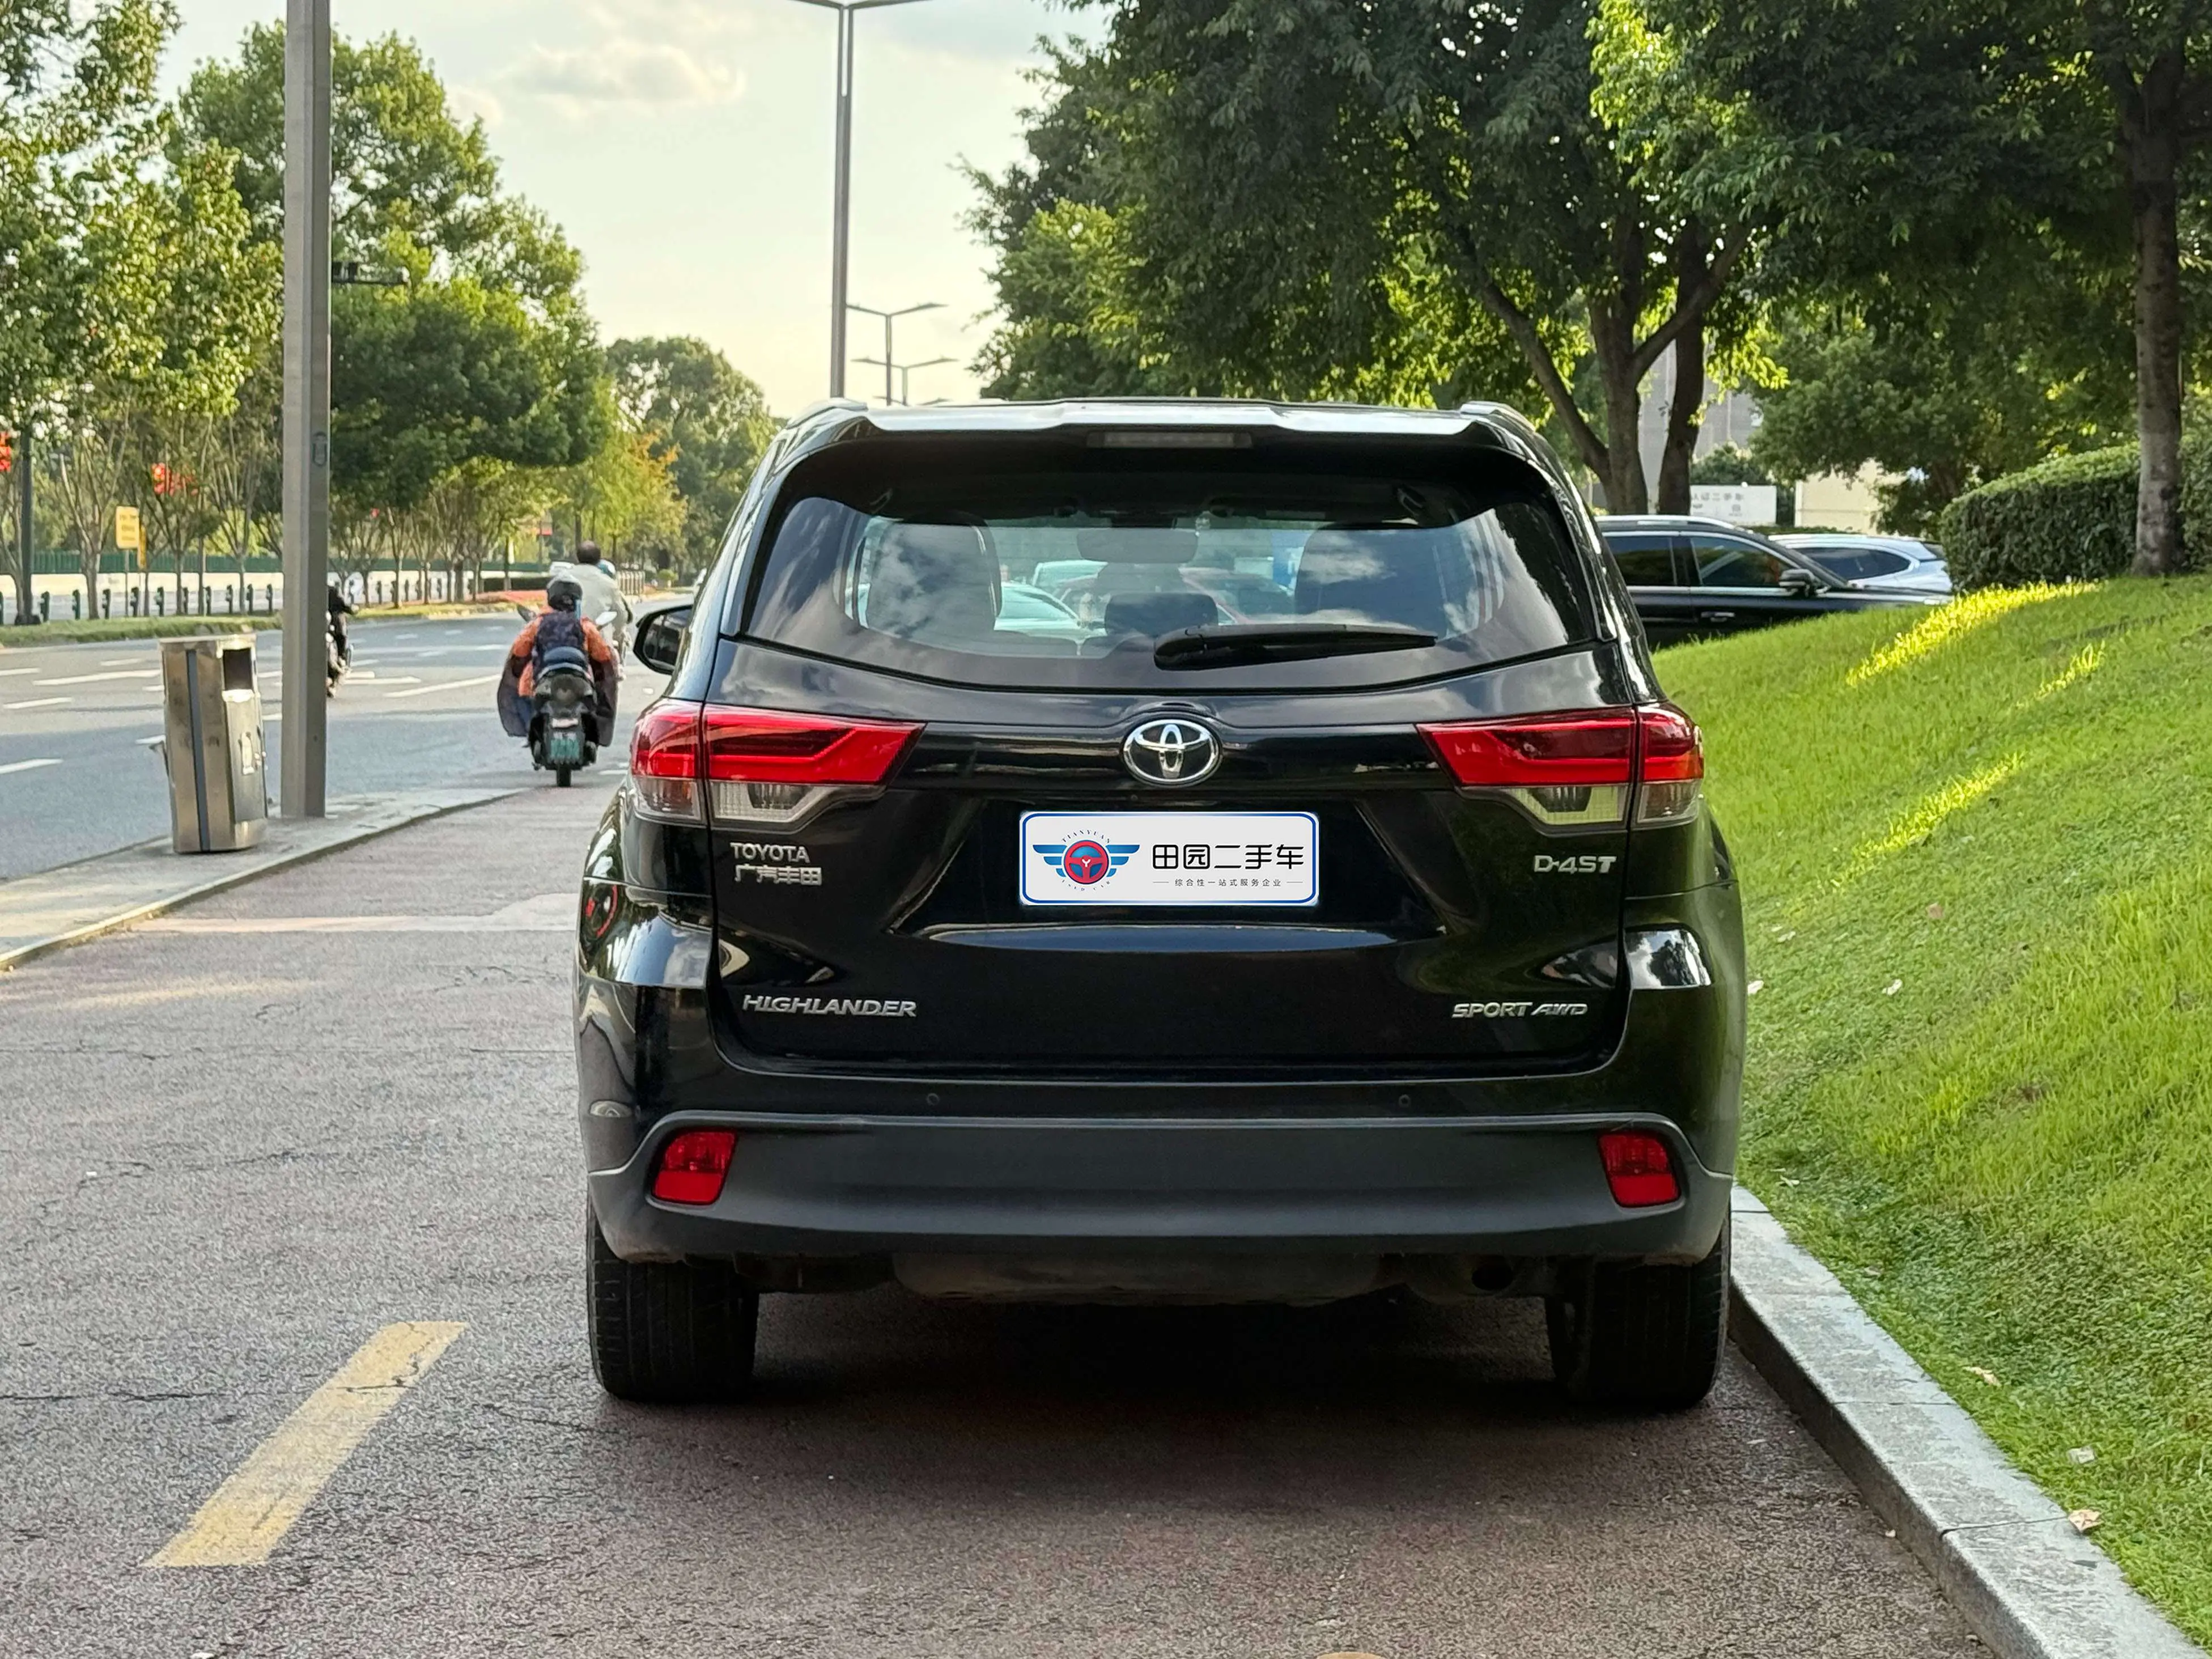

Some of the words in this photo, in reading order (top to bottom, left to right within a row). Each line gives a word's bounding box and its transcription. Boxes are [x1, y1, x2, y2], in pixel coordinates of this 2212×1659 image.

[730, 842, 810, 863] TOYOTA
[1153, 844, 1304, 869] 田园二手车
[734, 863, 821, 885] 广汽丰田
[742, 995, 916, 1017] HIGHLANDER
[1451, 1002, 1532, 1017] SPORT
[1531, 1003, 1587, 1015] AWD
